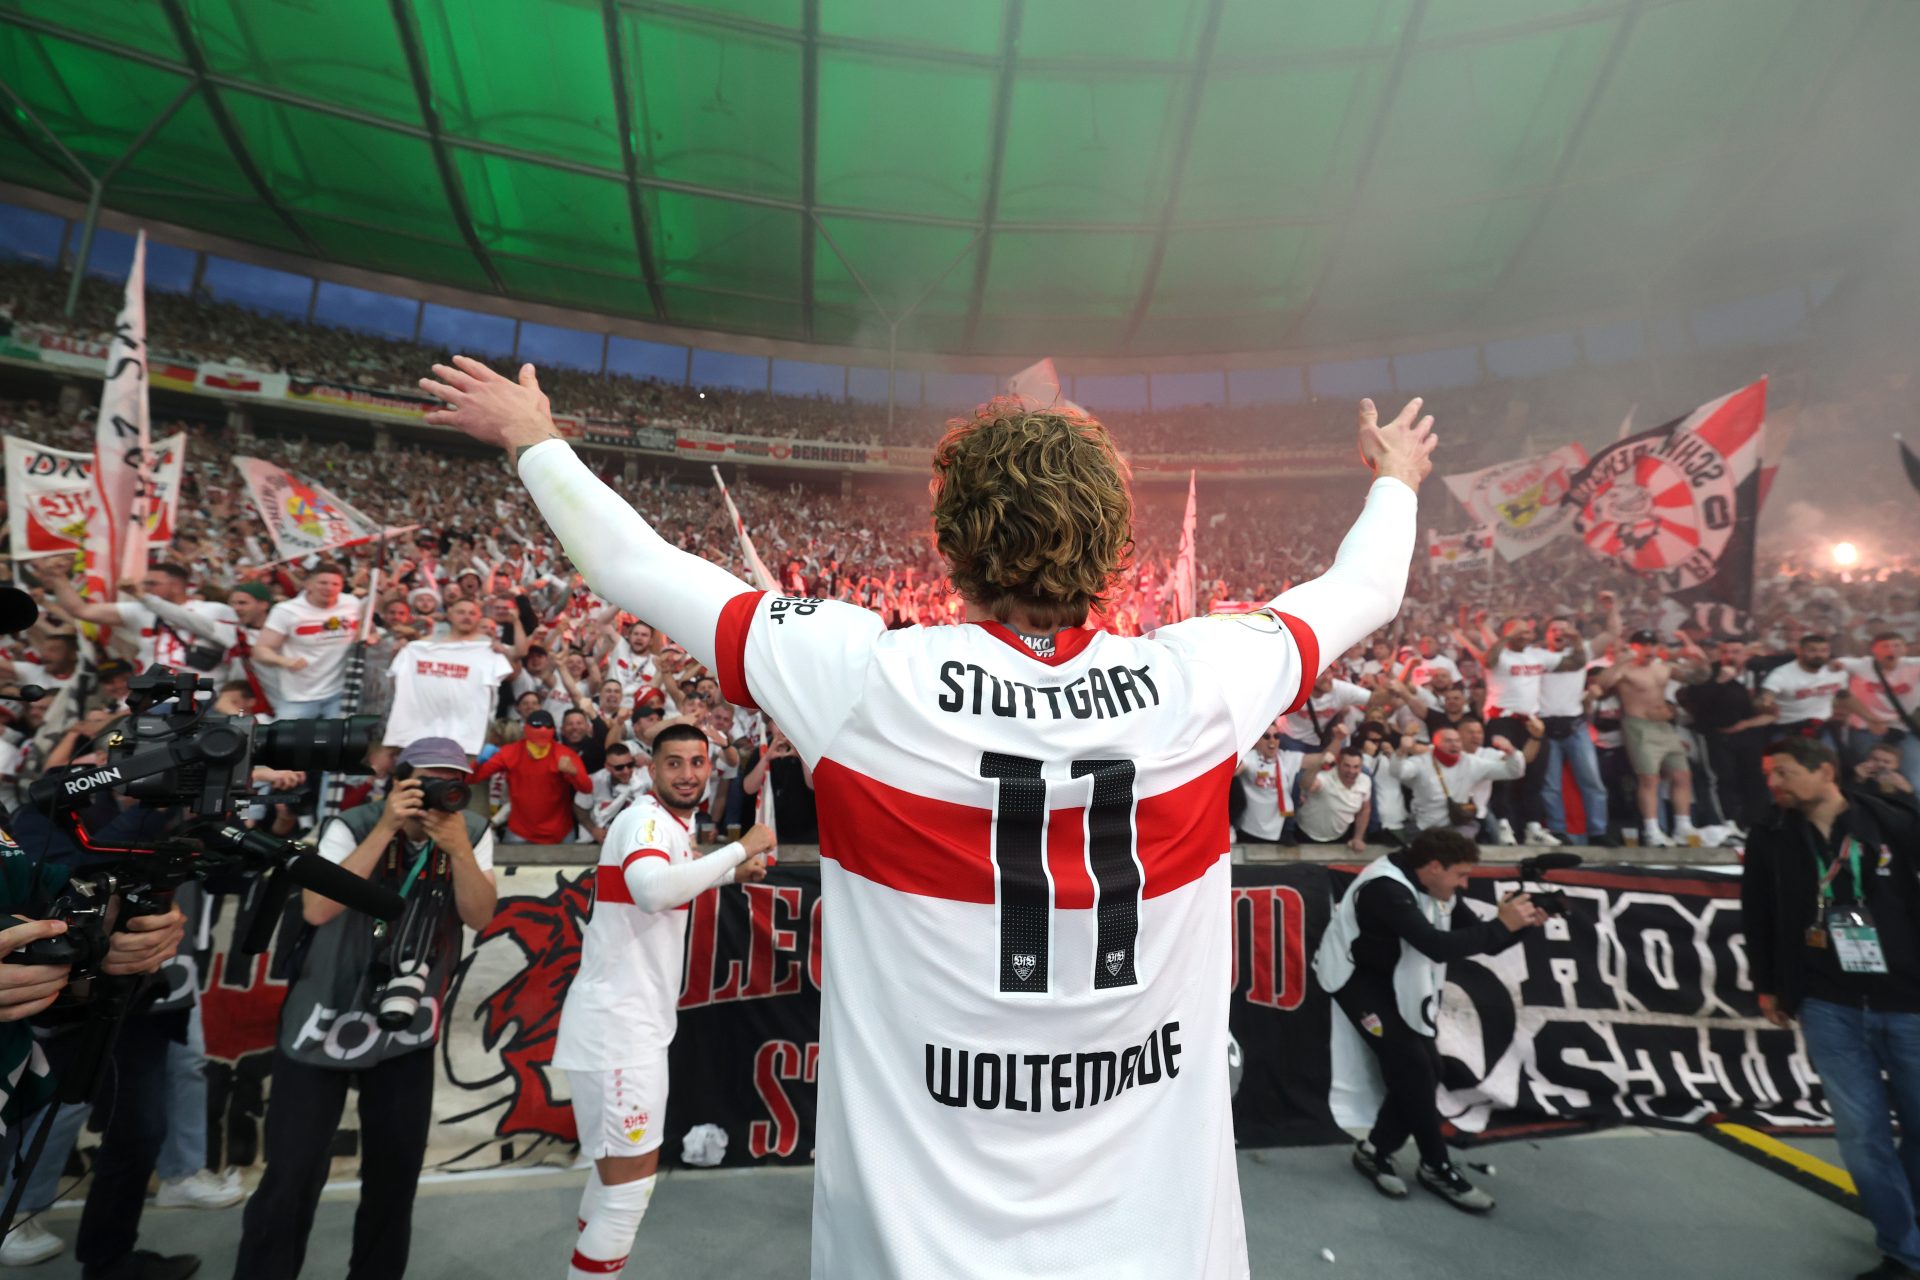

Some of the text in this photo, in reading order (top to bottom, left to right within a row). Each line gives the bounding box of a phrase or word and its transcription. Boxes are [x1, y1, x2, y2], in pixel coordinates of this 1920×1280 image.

[938, 660, 1160, 720] STUTTGART
[64, 767, 121, 795] RONIN
[980, 751, 1144, 995] 11
[925, 1021, 1182, 1113] WOLTEMADE
